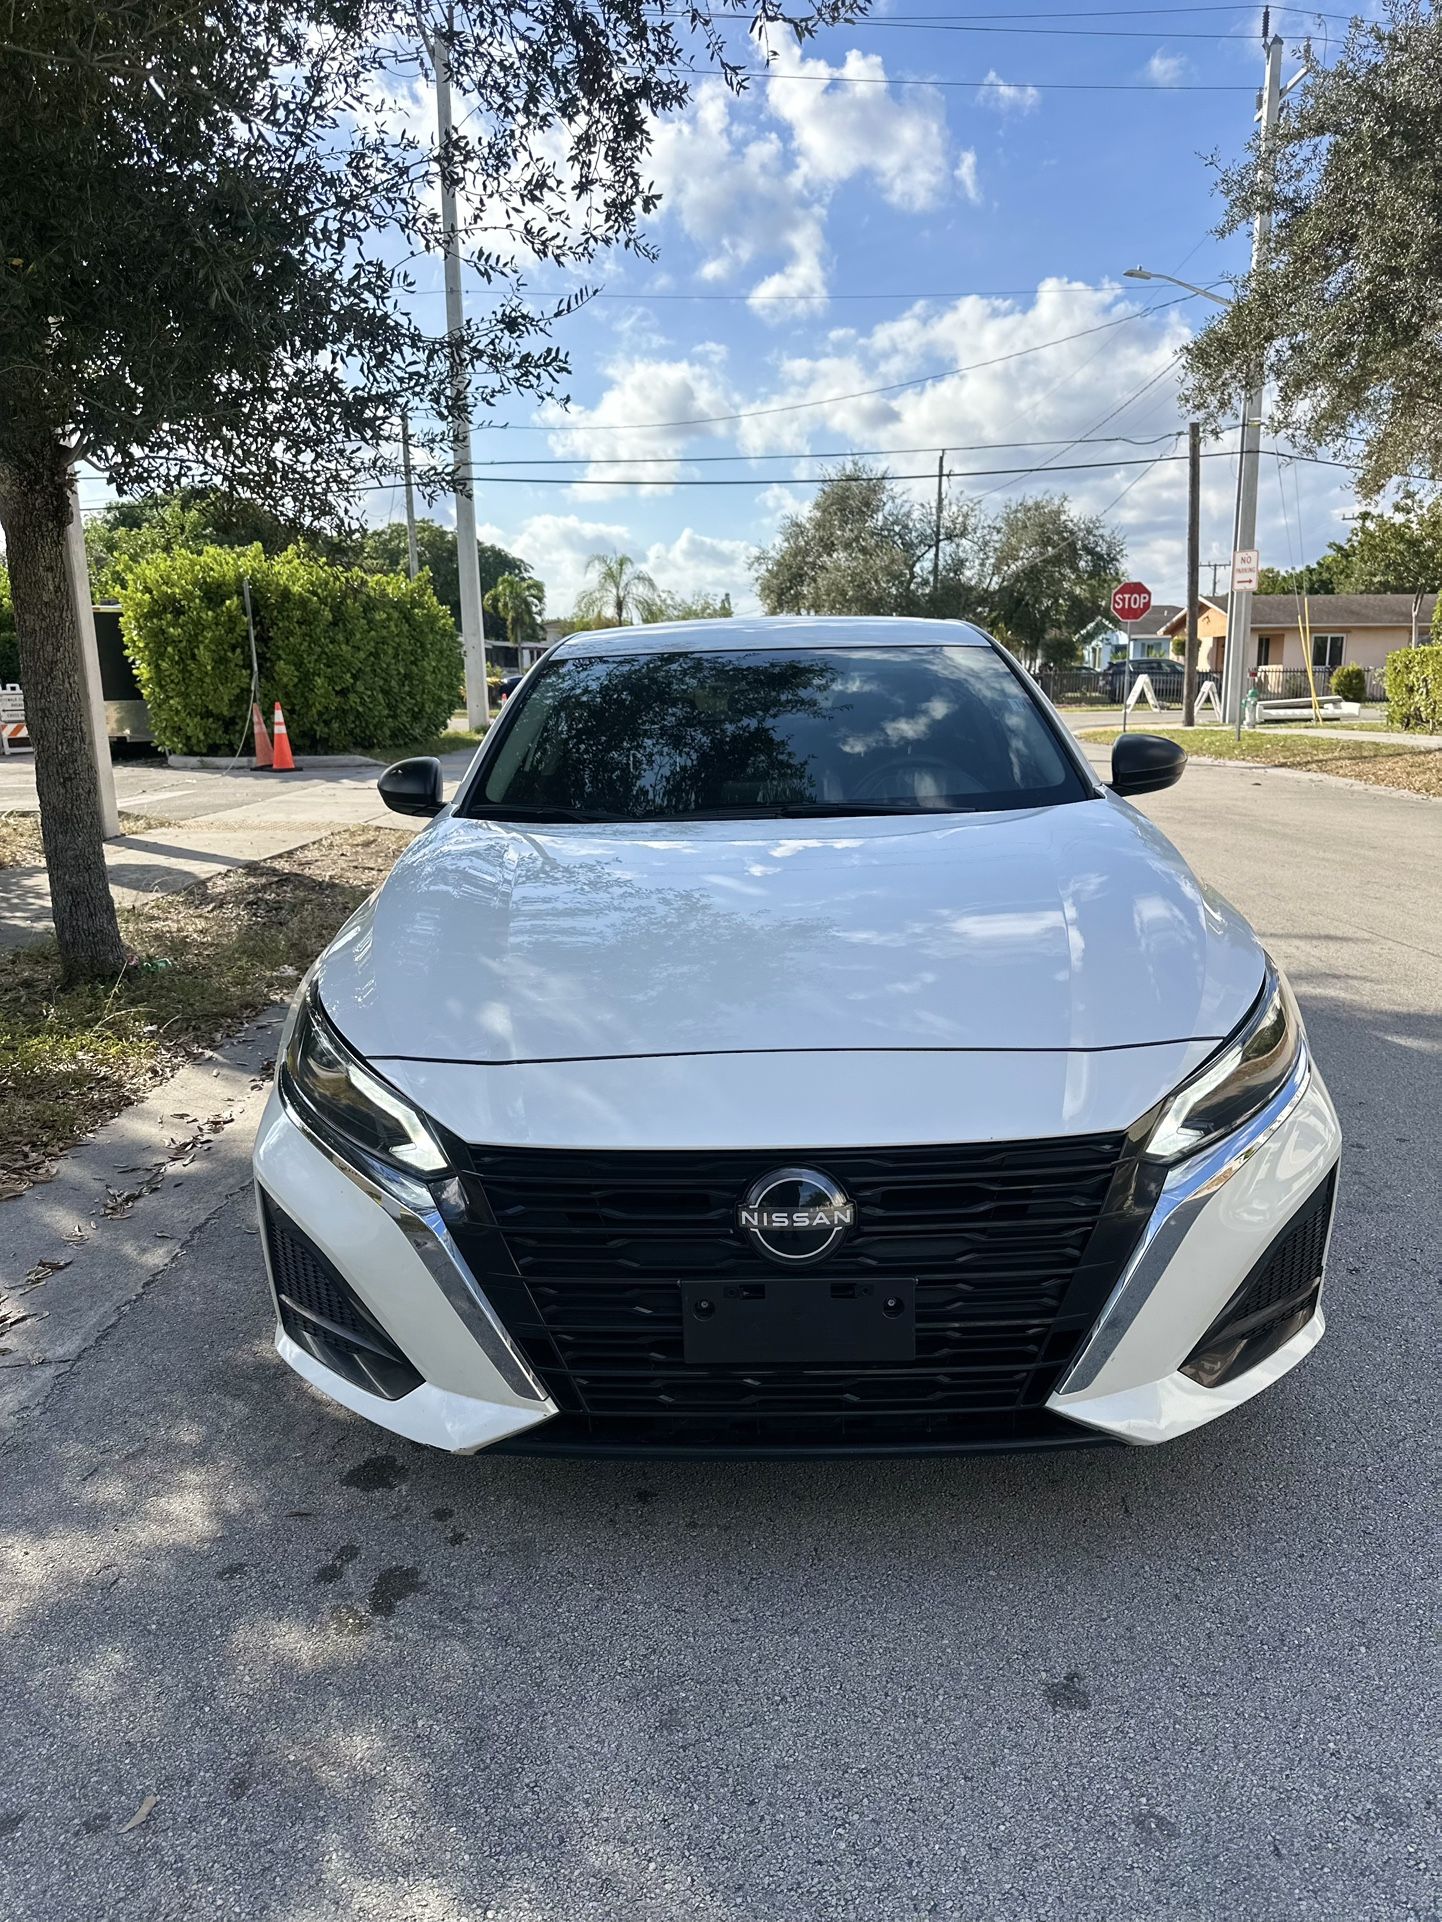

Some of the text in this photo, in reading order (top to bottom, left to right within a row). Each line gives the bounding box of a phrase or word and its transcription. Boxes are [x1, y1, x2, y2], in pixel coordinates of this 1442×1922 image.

[1240, 556, 1252, 565] NO
[1114, 593, 1149, 609] STOP
[741, 1209, 851, 1227] NISSAN
